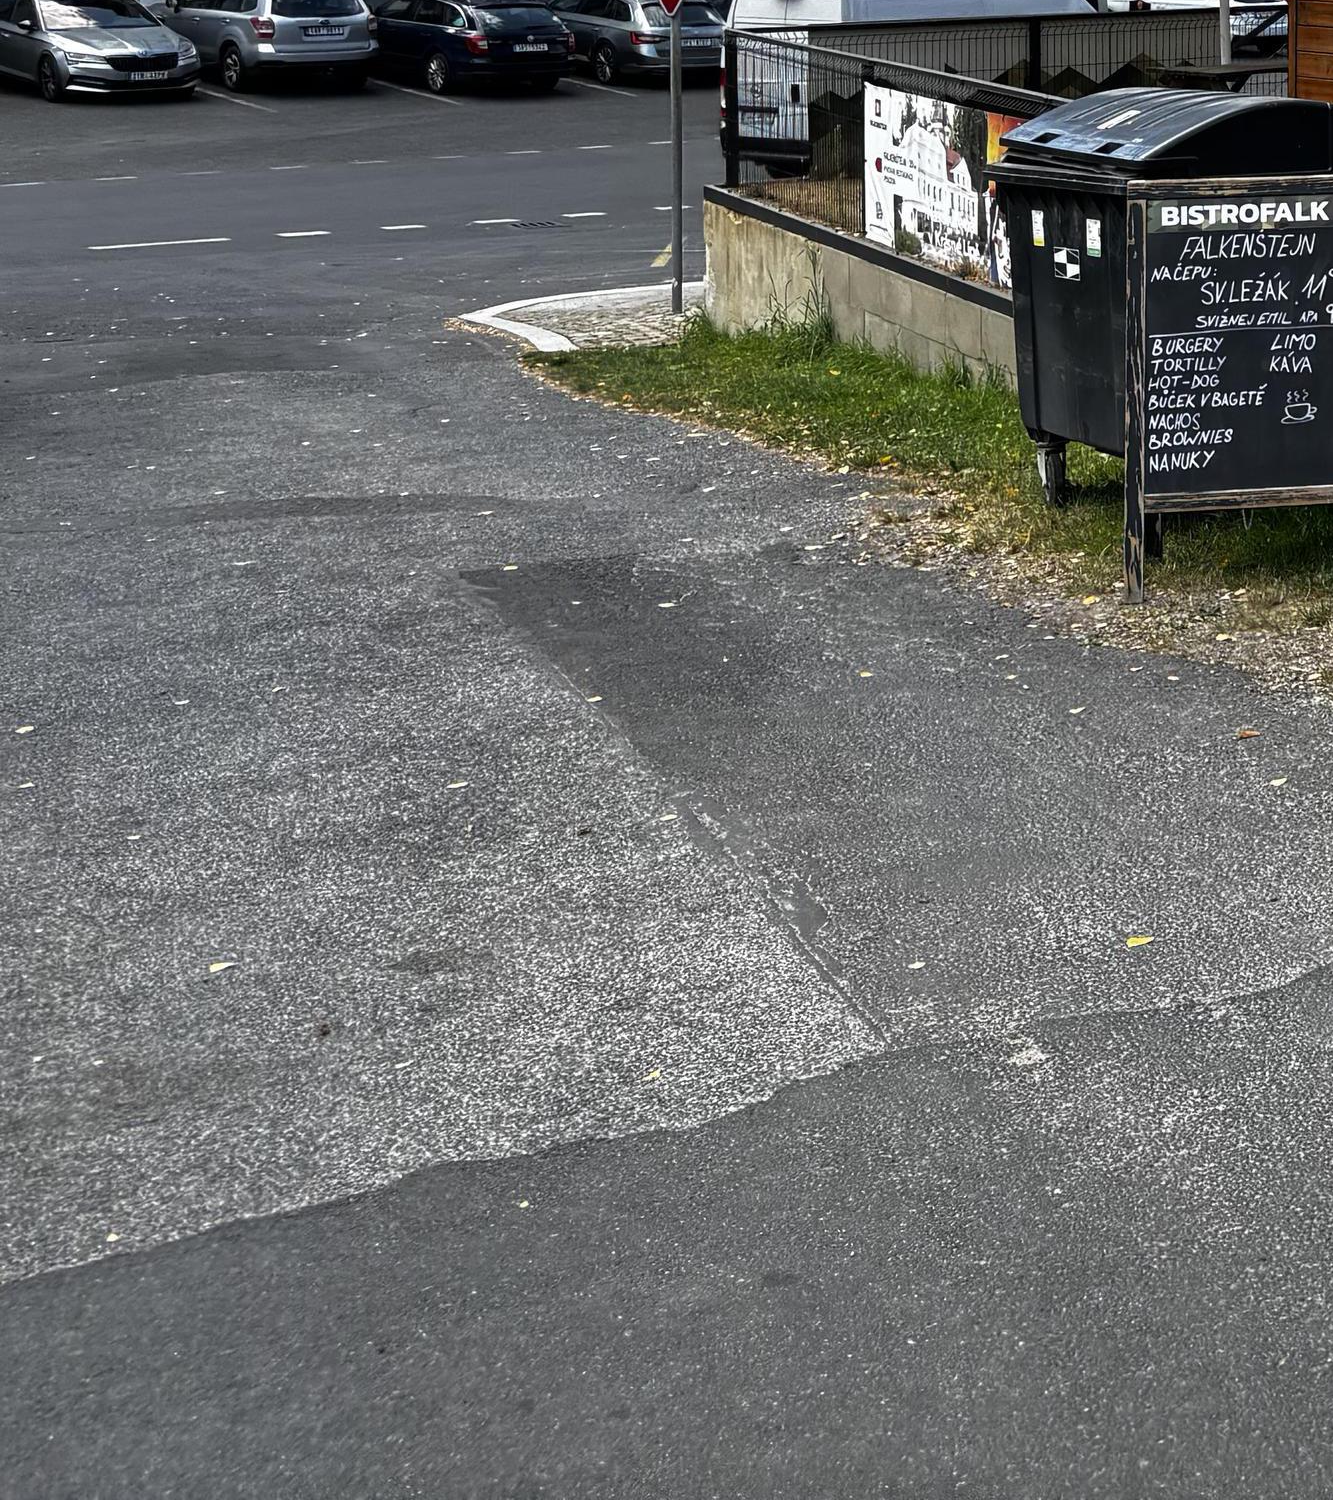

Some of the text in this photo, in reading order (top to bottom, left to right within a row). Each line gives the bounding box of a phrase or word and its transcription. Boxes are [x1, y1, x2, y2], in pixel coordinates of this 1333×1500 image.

[1161, 200, 1330, 227] BISTROFALK
[1299, 310, 1319, 323] APA
[1152, 337, 1224, 356] BURGERY
[1270, 333, 1317, 351] LIMO
[1150, 356, 1227, 375] TORTILLY
[1269, 350, 1313, 374] KÁVA
[1148, 374, 1220, 392] HOT-DOG
[1149, 412, 1201, 431] NACHOS
[1148, 428, 1234, 450] BROWNIES
[1149, 450, 1216, 474] NANUKY
